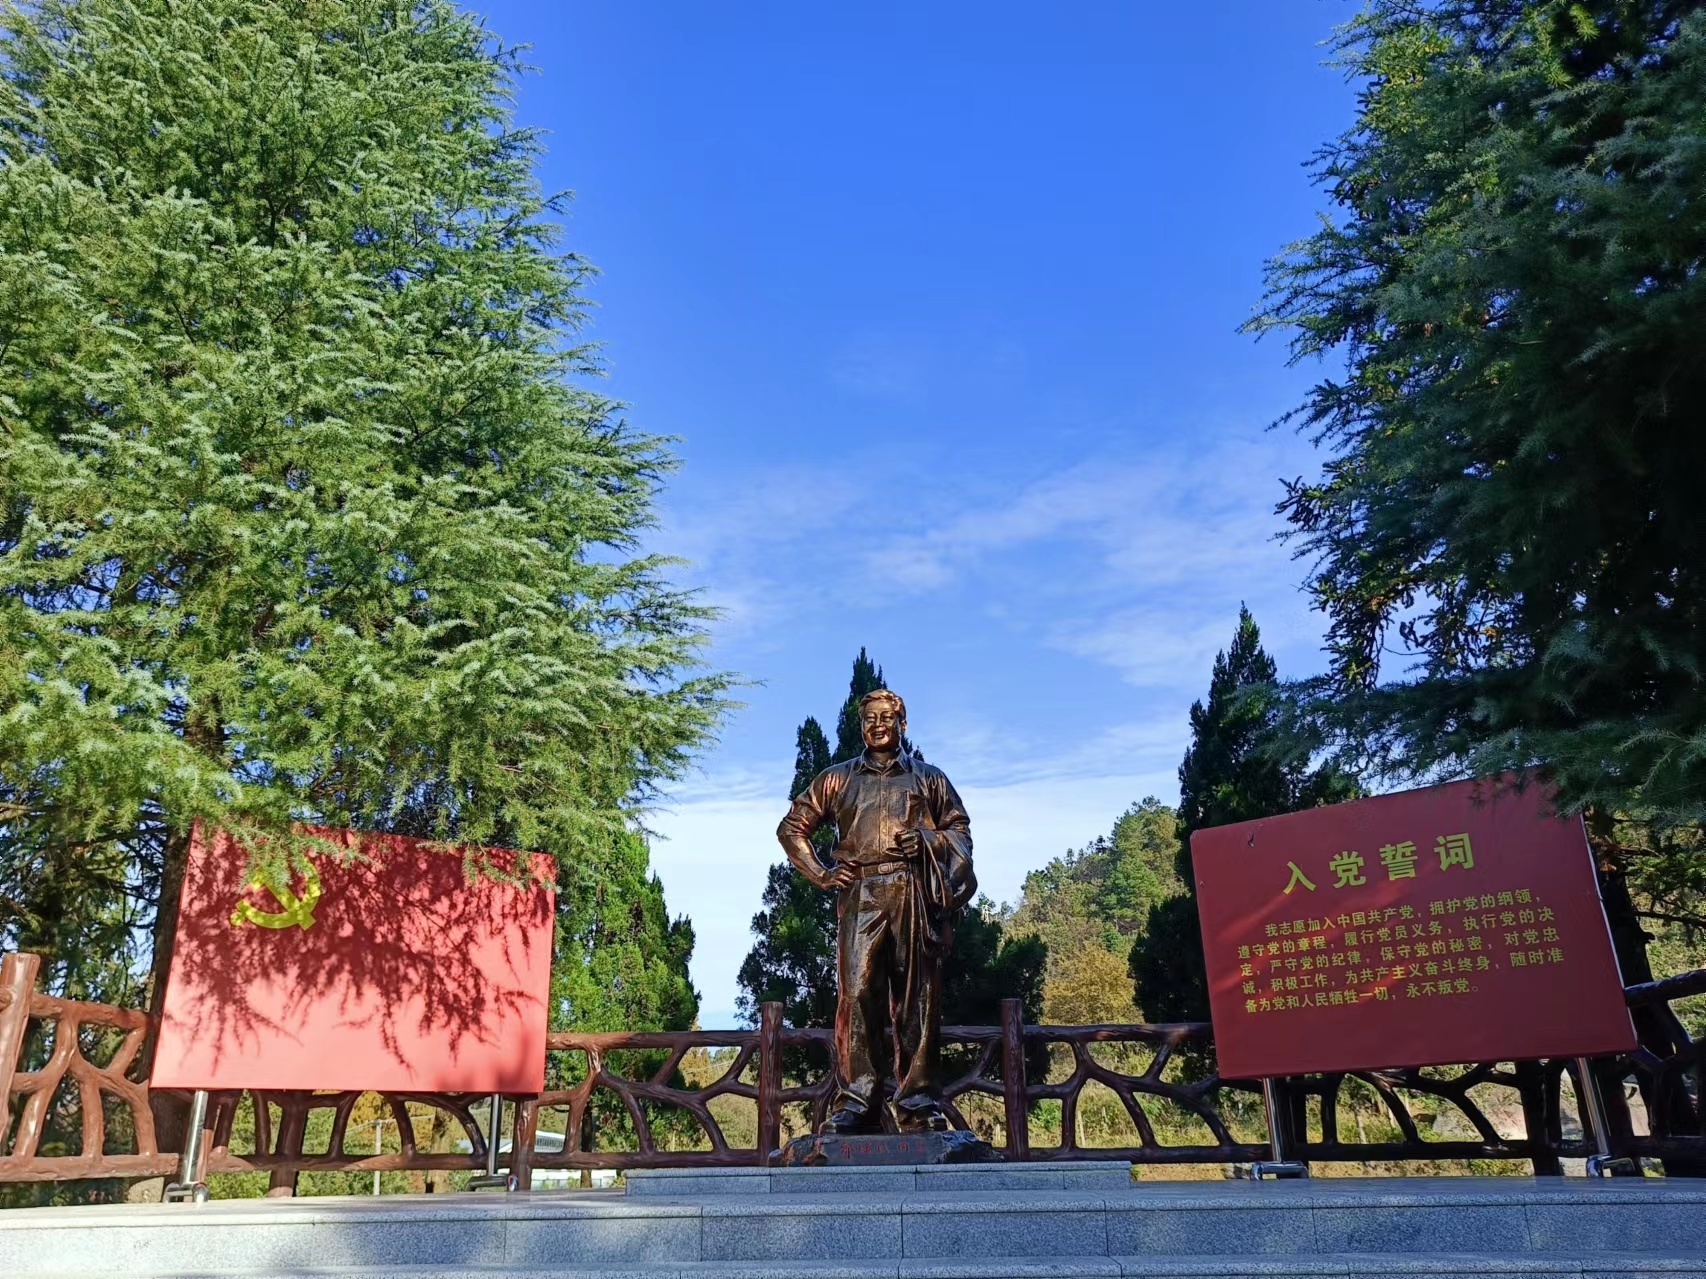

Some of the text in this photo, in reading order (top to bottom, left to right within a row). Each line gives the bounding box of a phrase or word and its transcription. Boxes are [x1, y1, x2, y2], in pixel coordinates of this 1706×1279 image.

[1282, 832, 1474, 894] 入党誓词
[1237, 906, 1555, 959] 遵守党的章程，履行党员义务，执行党的决
[1265, 889, 1541, 937] 我志愿加入中国共产党，拥护党的纲领，
[1240, 927, 1560, 977] 定，严守党的纪律，保守党的秘密，对党忠
[1242, 948, 1564, 994] 诚，积极工作，为共产主义奋斗终身，随时准
[1245, 978, 1479, 1013] 备为党和人民牺牲一切，永不叛党。
